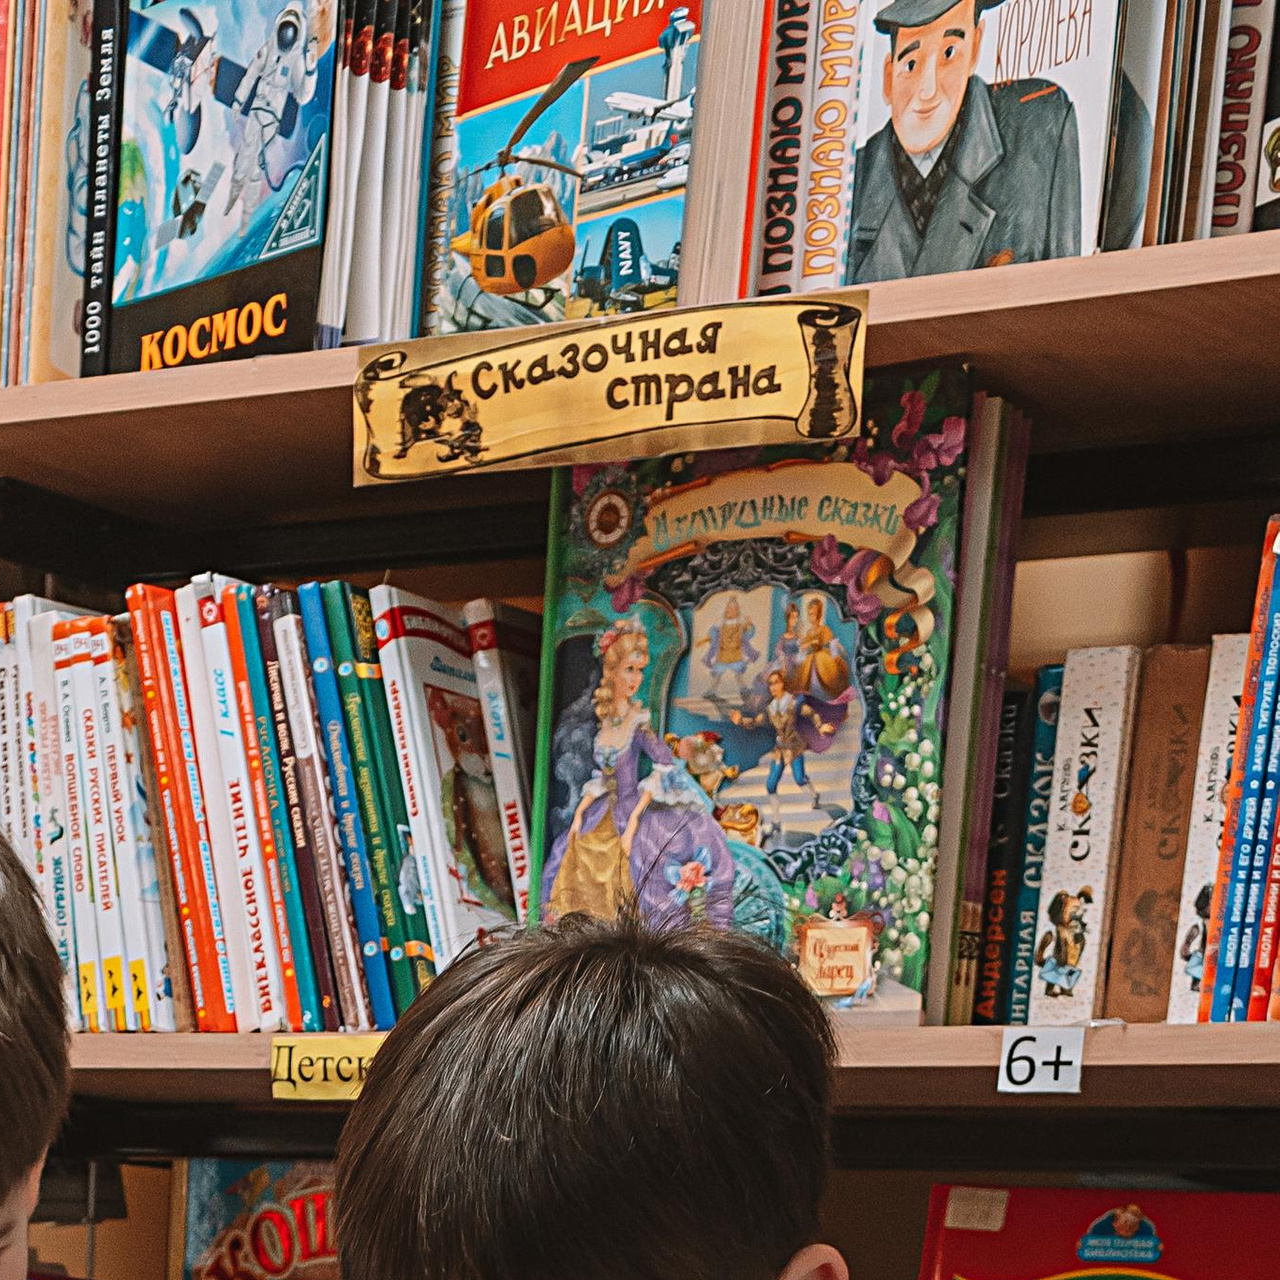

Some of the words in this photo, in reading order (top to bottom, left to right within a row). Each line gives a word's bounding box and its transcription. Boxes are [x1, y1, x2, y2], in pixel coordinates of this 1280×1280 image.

[96, 28, 114, 101] Земля
[94, 114, 112, 218] планеты
[763, 96, 804, 276] ПОЗНАЮ
[802, 98, 847, 277] ПОЗНАЮ
[90, 231, 106, 289] тайн
[617, 230, 632, 276] NAVY
[84, 301, 102, 354] 1000
[139, 293, 289, 371] КОСМОС
[470, 321, 723, 402] Сказочная
[605, 364, 783, 421] страна
[267, 660, 284, 712] Лисичка
[82, 708, 96, 760] СКАЗКИ
[64, 753, 81, 841] ВОЛШЕБНОЕ
[89, 767, 104, 825] РУССКИХ
[106, 743, 124, 803] ПЕРВЫЙ
[282, 755, 300, 806] Русские
[113, 807, 127, 844] УРОК
[228, 777, 251, 860] ЧТЕНИЕ
[290, 806, 307, 849] сказки
[72, 846, 86, 893] СЛОВО
[95, 833, 114, 912] ПИСАТЕЛЕЙ
[241, 868, 273, 1014] ВНЕКЛАССНОЕ
[973, 868, 1009, 1020] Андерсен
[1010, 910, 1036, 1026] НТАРНАЯ
[1005, 1035, 1075, 1087] 6+
